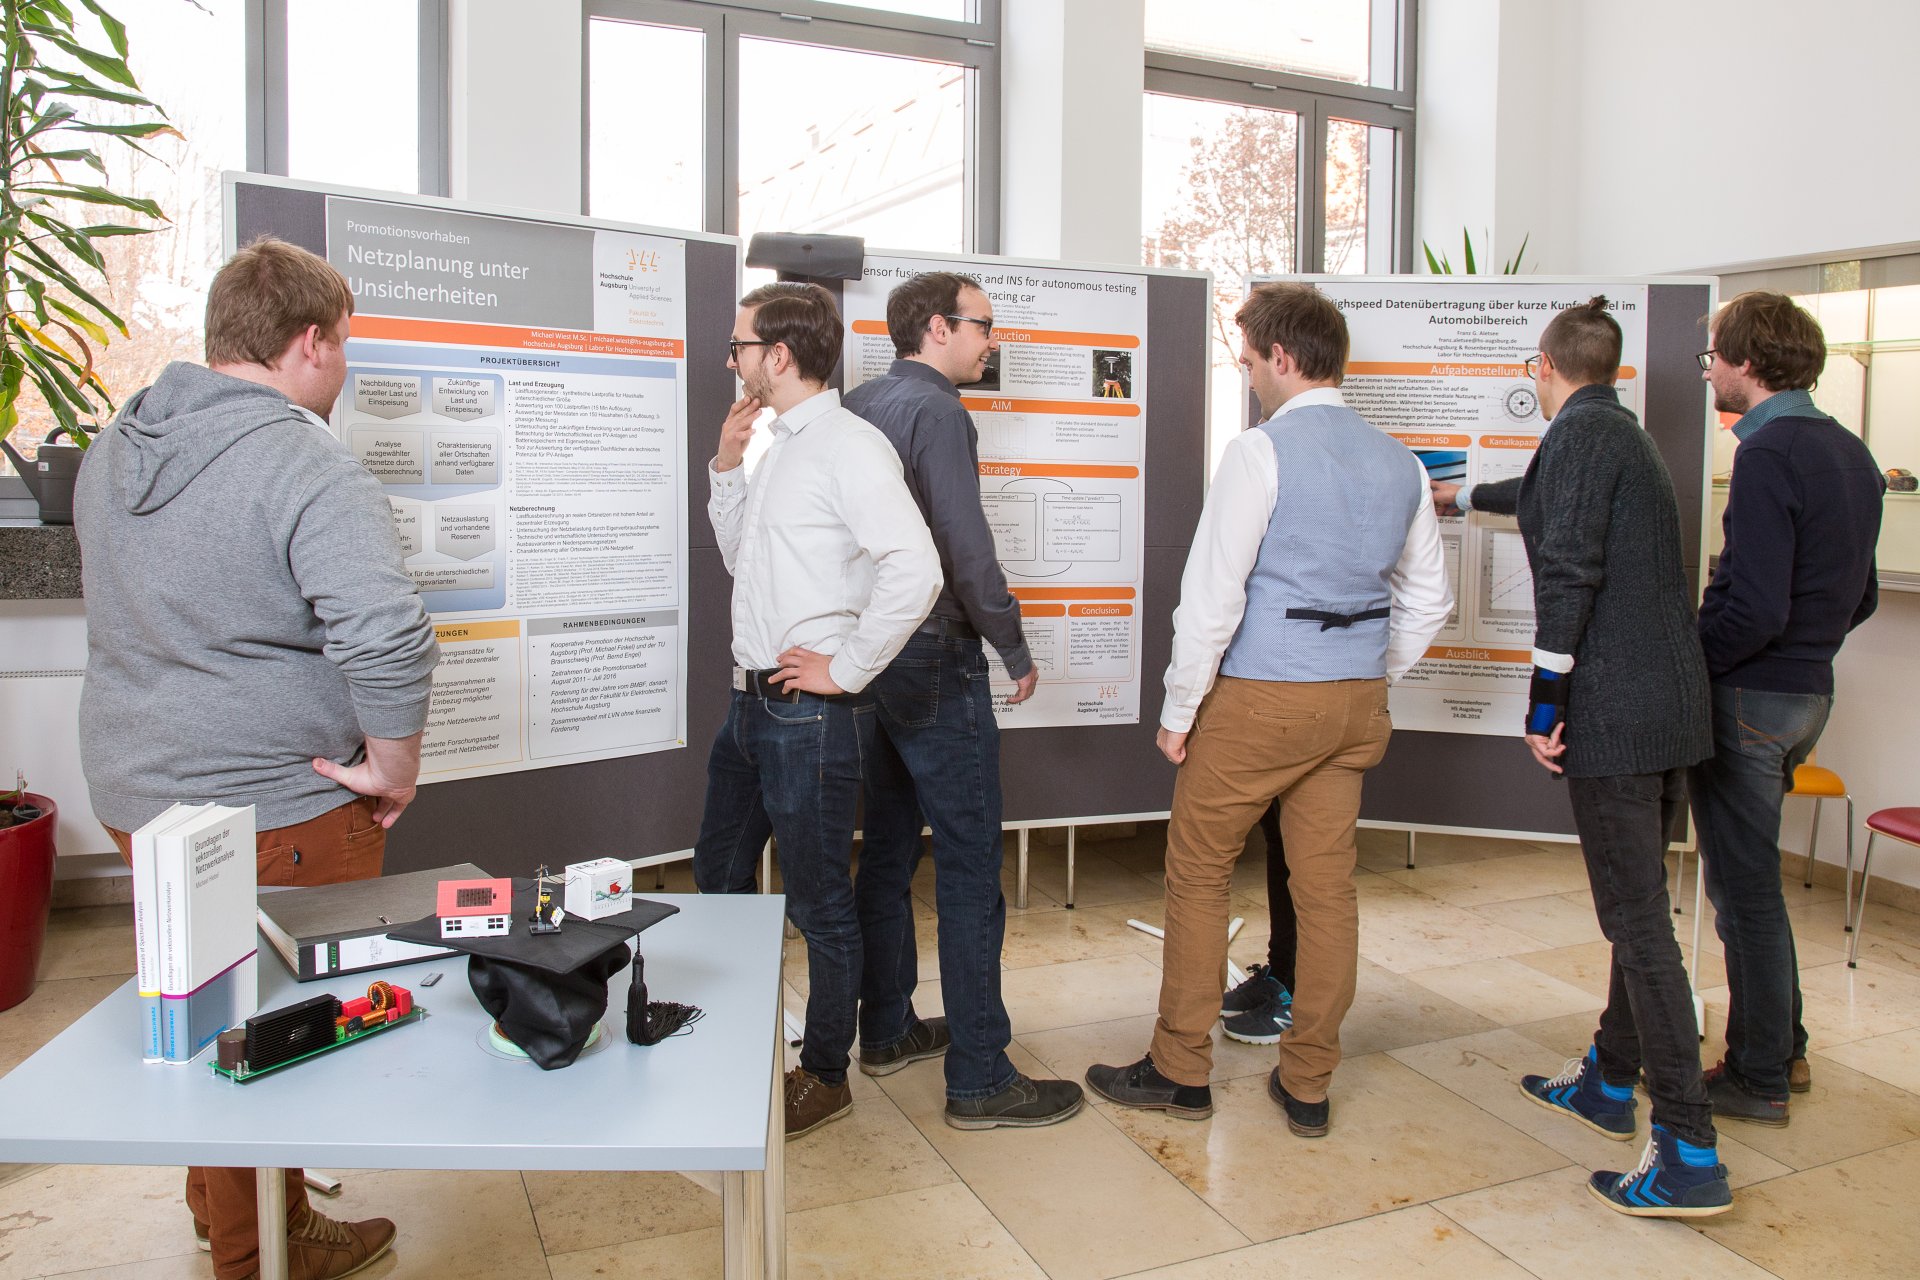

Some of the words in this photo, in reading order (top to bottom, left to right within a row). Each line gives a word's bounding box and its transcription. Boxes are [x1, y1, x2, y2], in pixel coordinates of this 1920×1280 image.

[347, 221, 470, 244] Promotionsvorhaben
[348, 246, 474, 278] Netzplanung
[480, 263, 529, 279] unter
[600, 273, 634, 281] Hochschule
[863, 268, 893, 277] ensor
[985, 275, 1004, 285] and
[1006, 275, 1023, 286] INS
[1025, 276, 1040, 287] for
[1042, 280, 1103, 291] autonomous
[1105, 283, 1137, 296] testing
[600, 281, 628, 290] Augsburg
[349, 278, 498, 306] Unsicherheiten
[988, 291, 1018, 304] racing
[1020, 294, 1036, 303] car
[1385, 300, 1486, 311] Datenübertragung
[1488, 300, 1514, 310] über
[1517, 300, 1547, 310] kurze
[1622, 301, 1636, 310] im
[1428, 315, 1528, 325] Automobilbereich
[531, 331, 555, 339] Michael
[993, 330, 1031, 341] duction
[522, 340, 557, 351] Hochschule
[556, 342, 584, 352] Augsburg
[588, 344, 605, 354] Labor
[605, 345, 614, 354] für
[614, 347, 674, 356] Hochspannungstechnik
[480, 357, 560, 367] PROJEKTÜBERSICHT
[1430, 365, 1525, 378] Aufgabenstellung
[360, 380, 403, 390] Nachbildung
[447, 378, 481, 388] Zukünftige
[534, 381, 565, 389] Erzeugung
[438, 387, 477, 397] Entwicklung
[368, 398, 409, 408] Einspeisung
[991, 400, 1012, 411] AIM
[445, 406, 483, 415] Einspeisung
[1432, 436, 1450, 444] HSD
[1489, 438, 1539, 447] Kanalkapazit
[436, 442, 492, 450] Charakterisierung
[366, 450, 411, 458] ausgewählter
[459, 460, 495, 468] verfügbarer
[455, 468, 475, 476] Daten
[980, 465, 1022, 477] Strategy
[414, 579, 457, 587] ngsvarianten
[1081, 607, 1120, 615] Conclusion
[562, 617, 646, 628] RAHMENBEDINGUNGEN
[435, 630, 469, 638] ZUNGEN
[1445, 649, 1490, 660] Ausblick
[465, 656, 500, 664] dezentraler
[431, 687, 490, 697] Netzberechnungen
[432, 698, 462, 706] Einbezug
[462, 695, 493, 703] möglicher
[447, 716, 487, 725] Netzbereiche
[447, 735, 500, 746] Forschungsarbeit
[458, 744, 500, 753] Netzbetreiber
[195, 833, 221, 851] Grundlagen
[222, 829, 230, 838] der
[196, 850, 235, 875] Netzwerkanalyse
